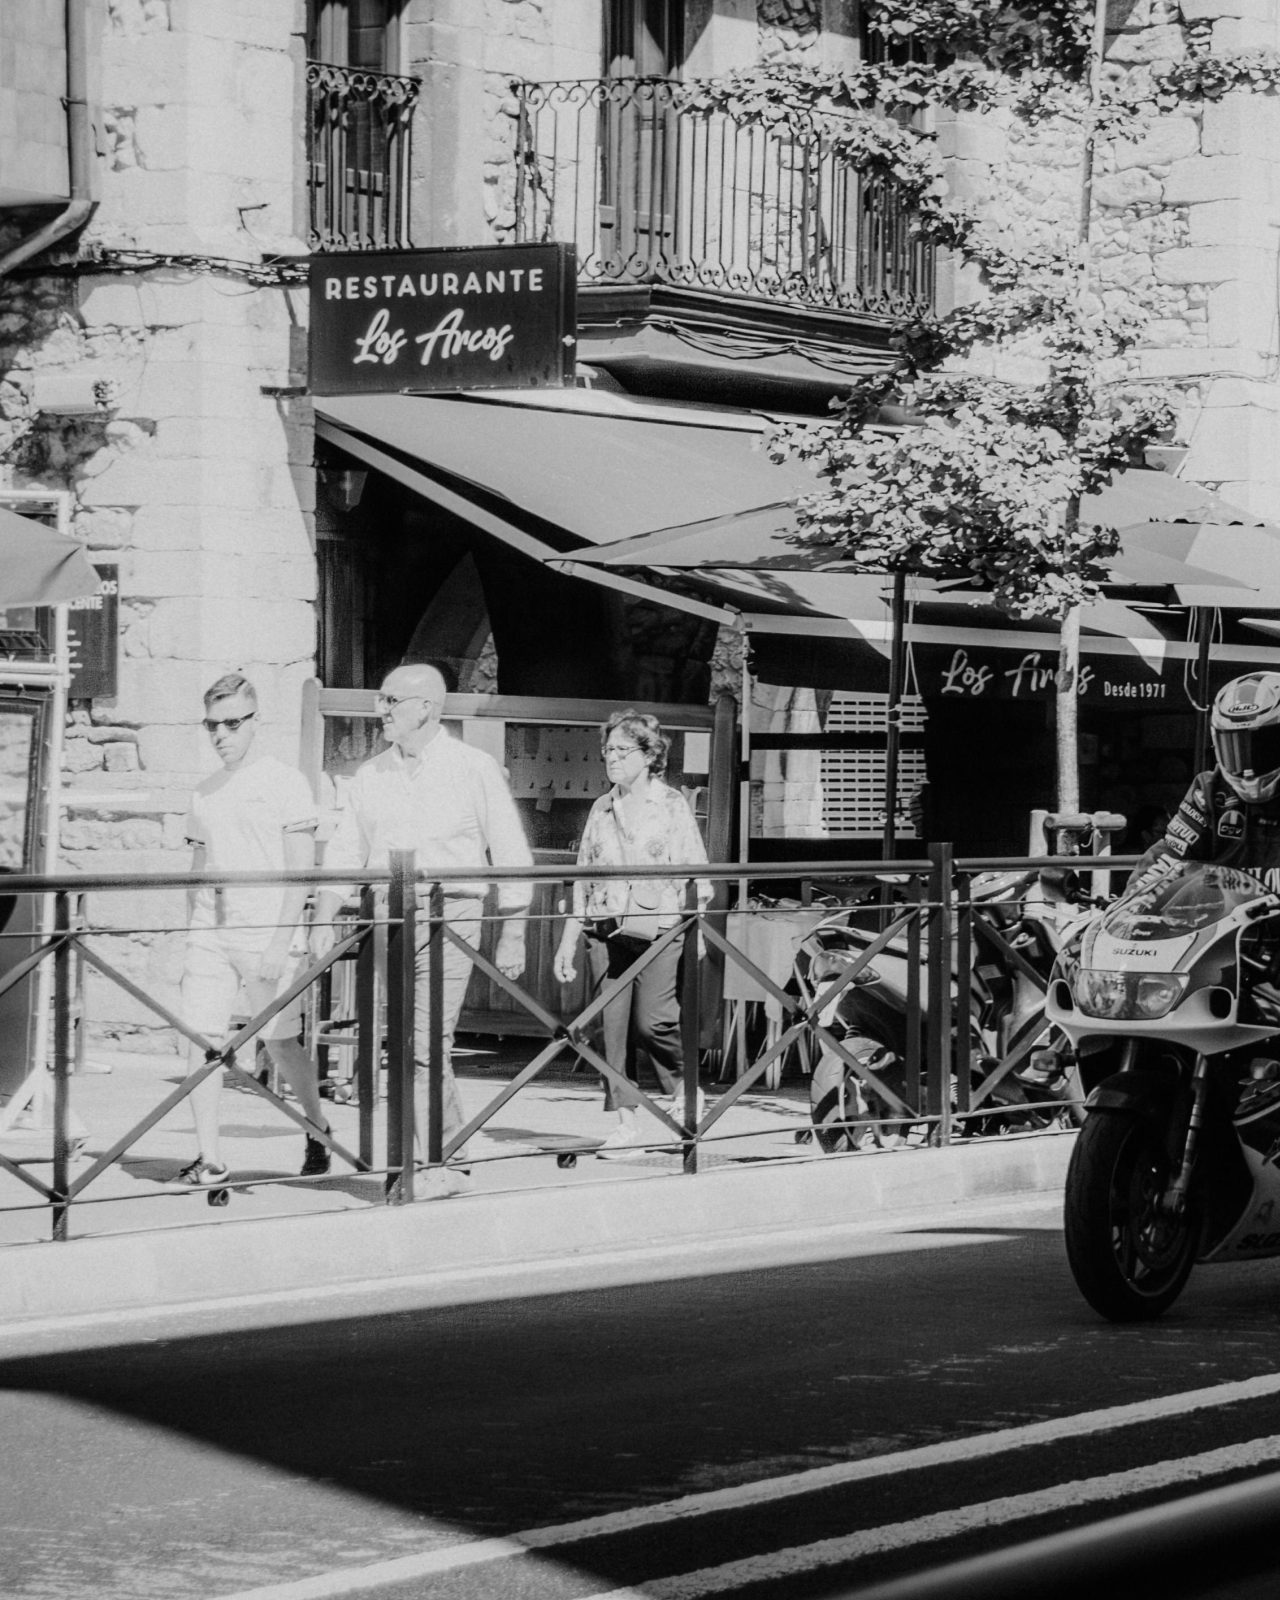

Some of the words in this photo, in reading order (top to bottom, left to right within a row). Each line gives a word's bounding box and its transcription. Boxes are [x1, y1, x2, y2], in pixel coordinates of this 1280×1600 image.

[325, 268, 543, 300] RESTAURANTE
[353, 308, 408, 364] Los
[415, 308, 514, 365] Arcos
[941, 649, 994, 696] Los
[1005, 652, 1095, 697] Ars
[1104, 681, 1137, 698] Desde
[1140, 683, 1166, 698] 1971
[1112, 948, 1158, 957] SUZUKI
